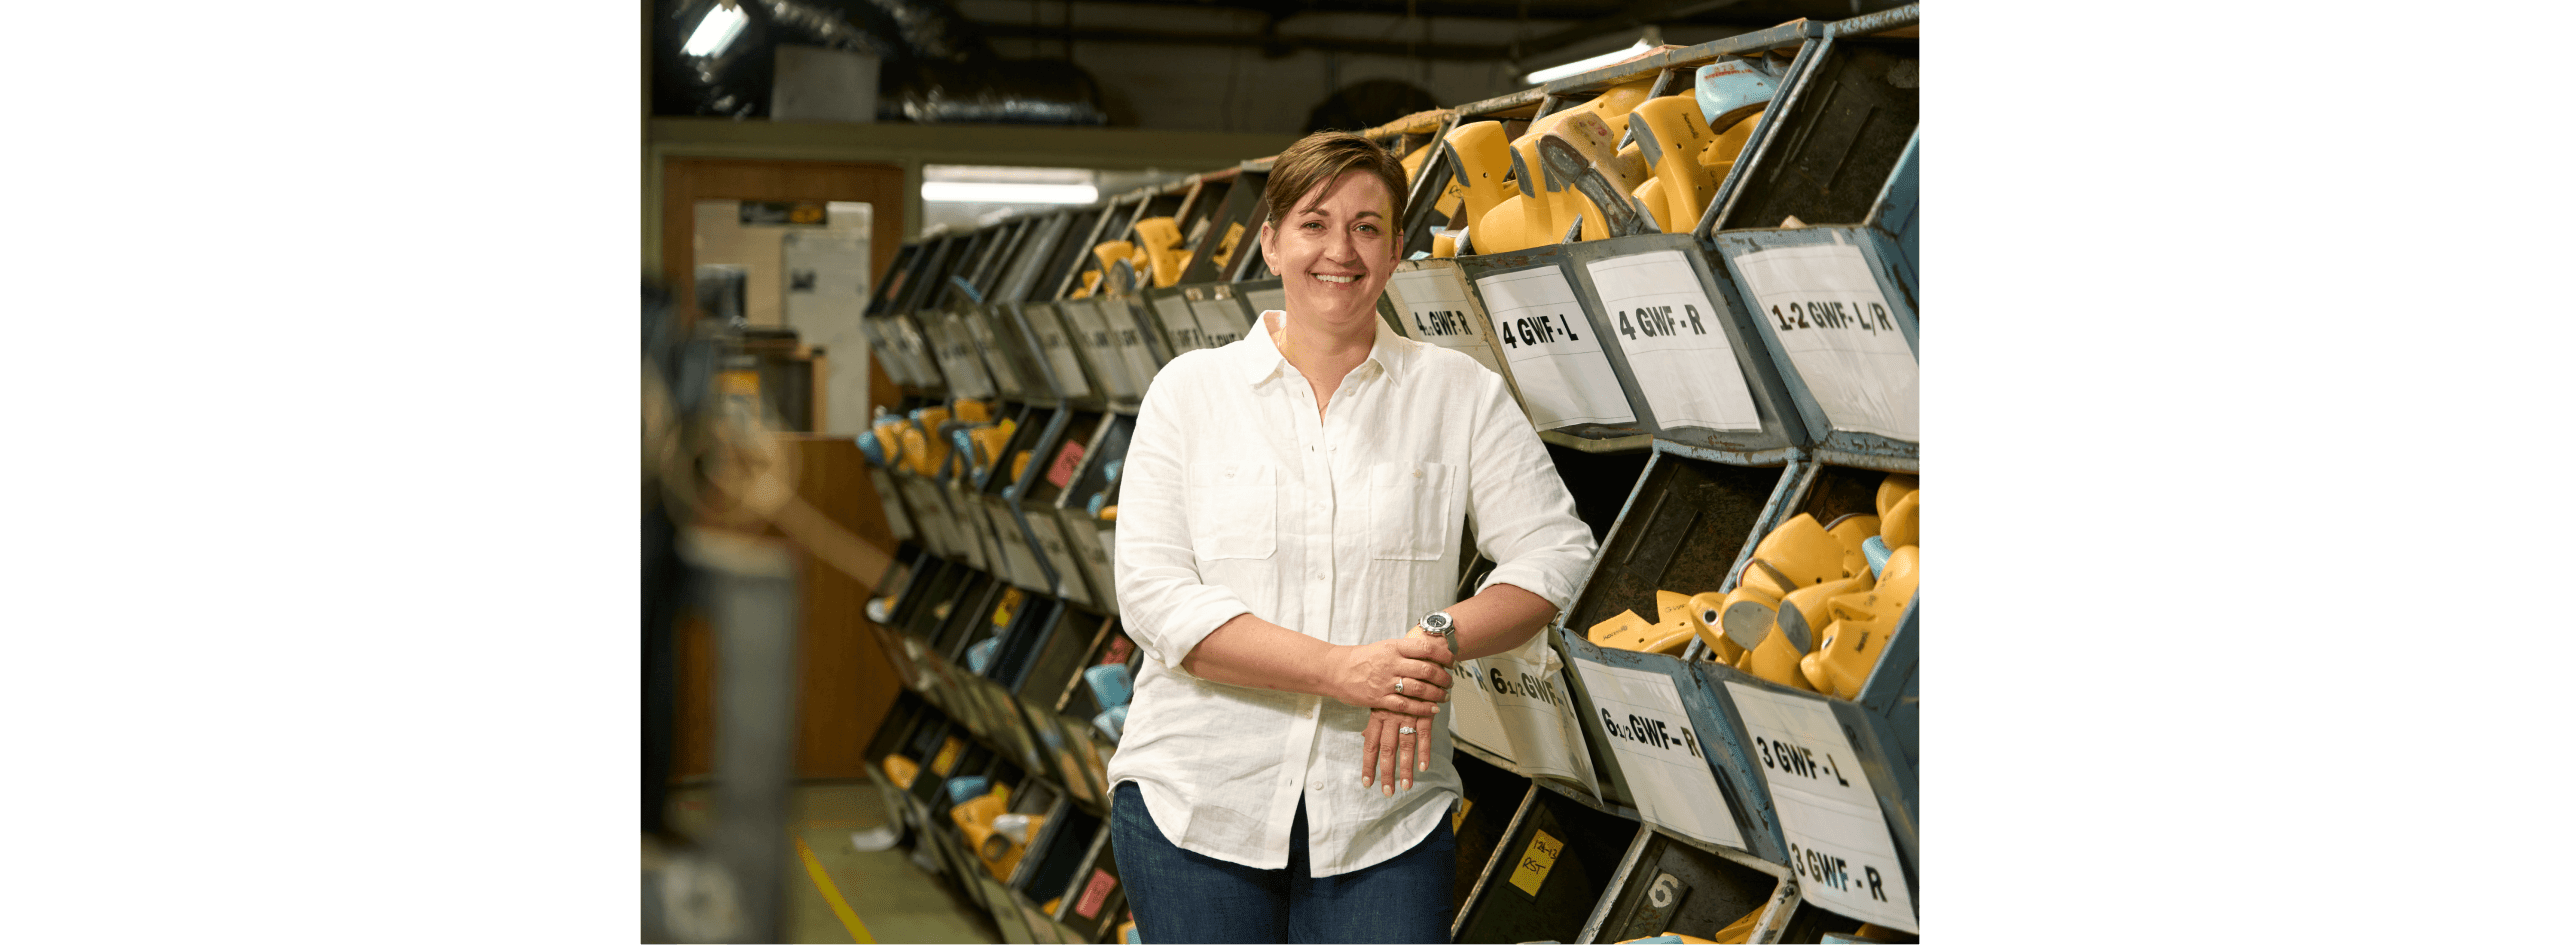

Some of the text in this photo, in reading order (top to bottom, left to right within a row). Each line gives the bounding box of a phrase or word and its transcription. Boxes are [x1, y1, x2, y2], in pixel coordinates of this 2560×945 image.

[1502, 321, 1518, 349] 4
[1618, 310, 1637, 341] 4
[1771, 302, 1811, 331] 1-2
[1853, 302, 1894, 337] L/R
[1756, 736, 1774, 769] 3
[1791, 843, 1806, 877] 3
[1647, 872, 1679, 908] 6
